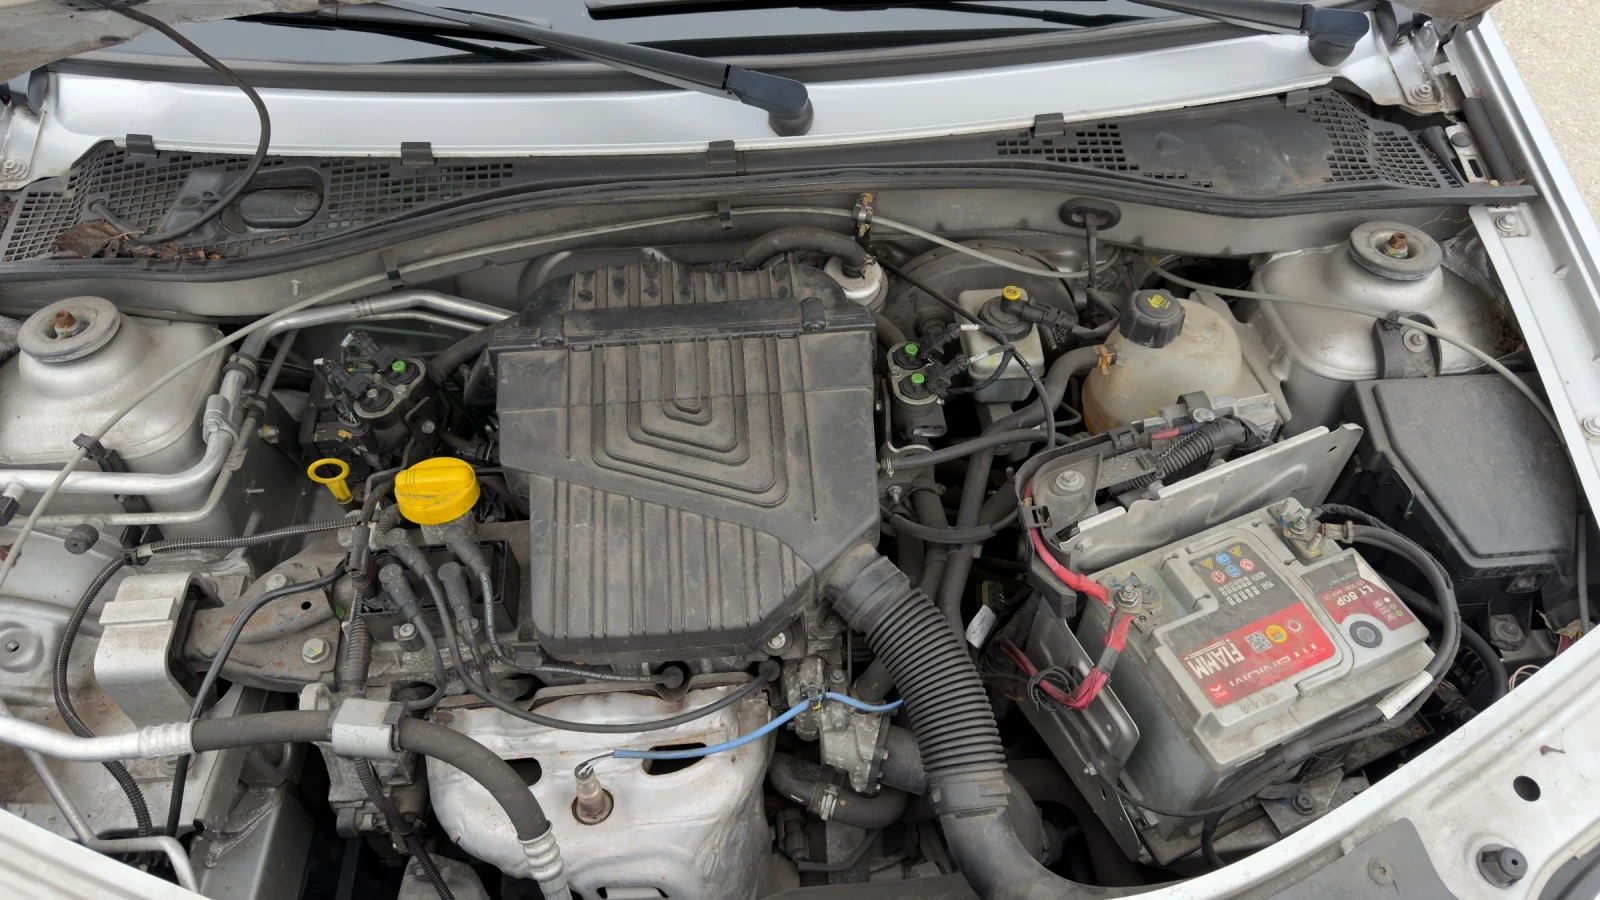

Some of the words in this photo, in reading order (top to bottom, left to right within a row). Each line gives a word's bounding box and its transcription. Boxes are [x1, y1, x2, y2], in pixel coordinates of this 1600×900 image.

[1358, 584, 1374, 596] L1
[1336, 591, 1358, 606] 50P
[1187, 640, 1245, 680] FIAMM
[1228, 643, 1326, 691] TITANIUM
[1214, 690, 1227, 698] PRO
